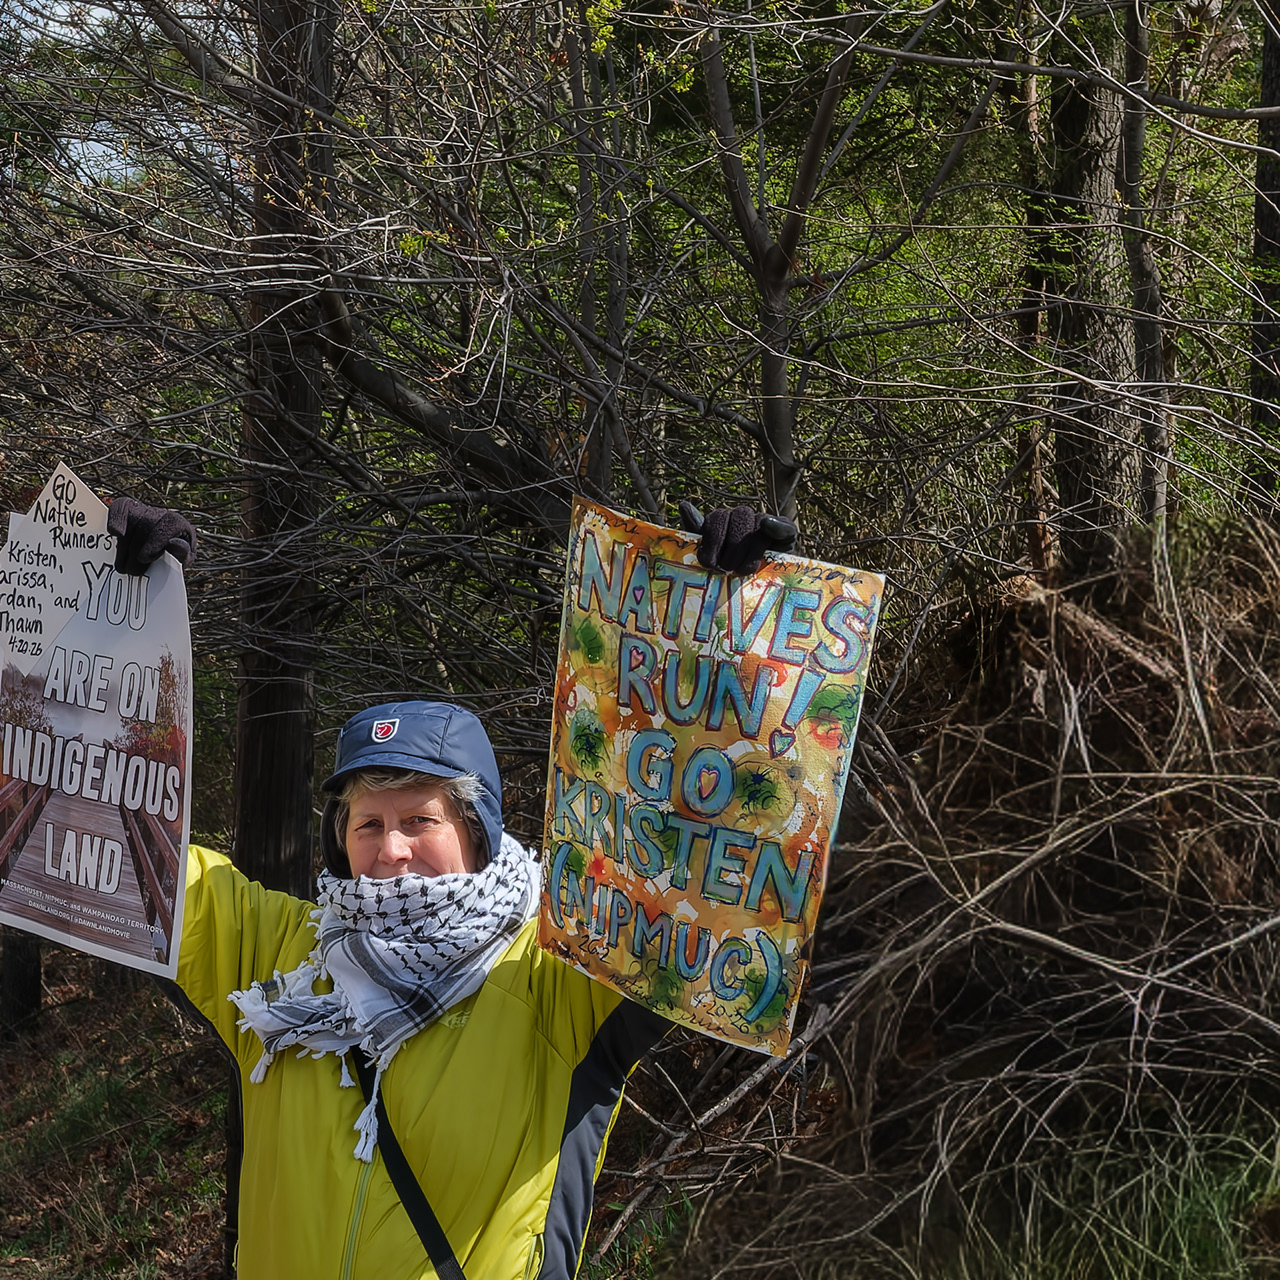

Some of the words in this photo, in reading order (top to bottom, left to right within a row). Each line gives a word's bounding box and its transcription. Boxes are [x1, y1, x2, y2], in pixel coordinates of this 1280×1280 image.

[33, 499, 87, 527] Native
[52, 474, 77, 505] GO
[8, 540, 64, 574] Kristen,
[49, 526, 113, 551] Runners
[54, 590, 80, 612] and
[81, 560, 150, 632] YOU
[577, 524, 874, 675] NATIVES
[43, 645, 113, 713] ARE
[118, 661, 161, 724] ON
[2, 723, 181, 823] INDIGENOUS
[627, 728, 737, 818] GO
[44, 822, 124, 896] LAND
[553, 765, 818, 924] KRISTEN
[70, 903, 81, 912] and
[82, 907, 126, 925] WAMPANOAG
[126, 919, 164, 935] TERRITORY
[548, 841, 789, 1025] (NIPMUC)
